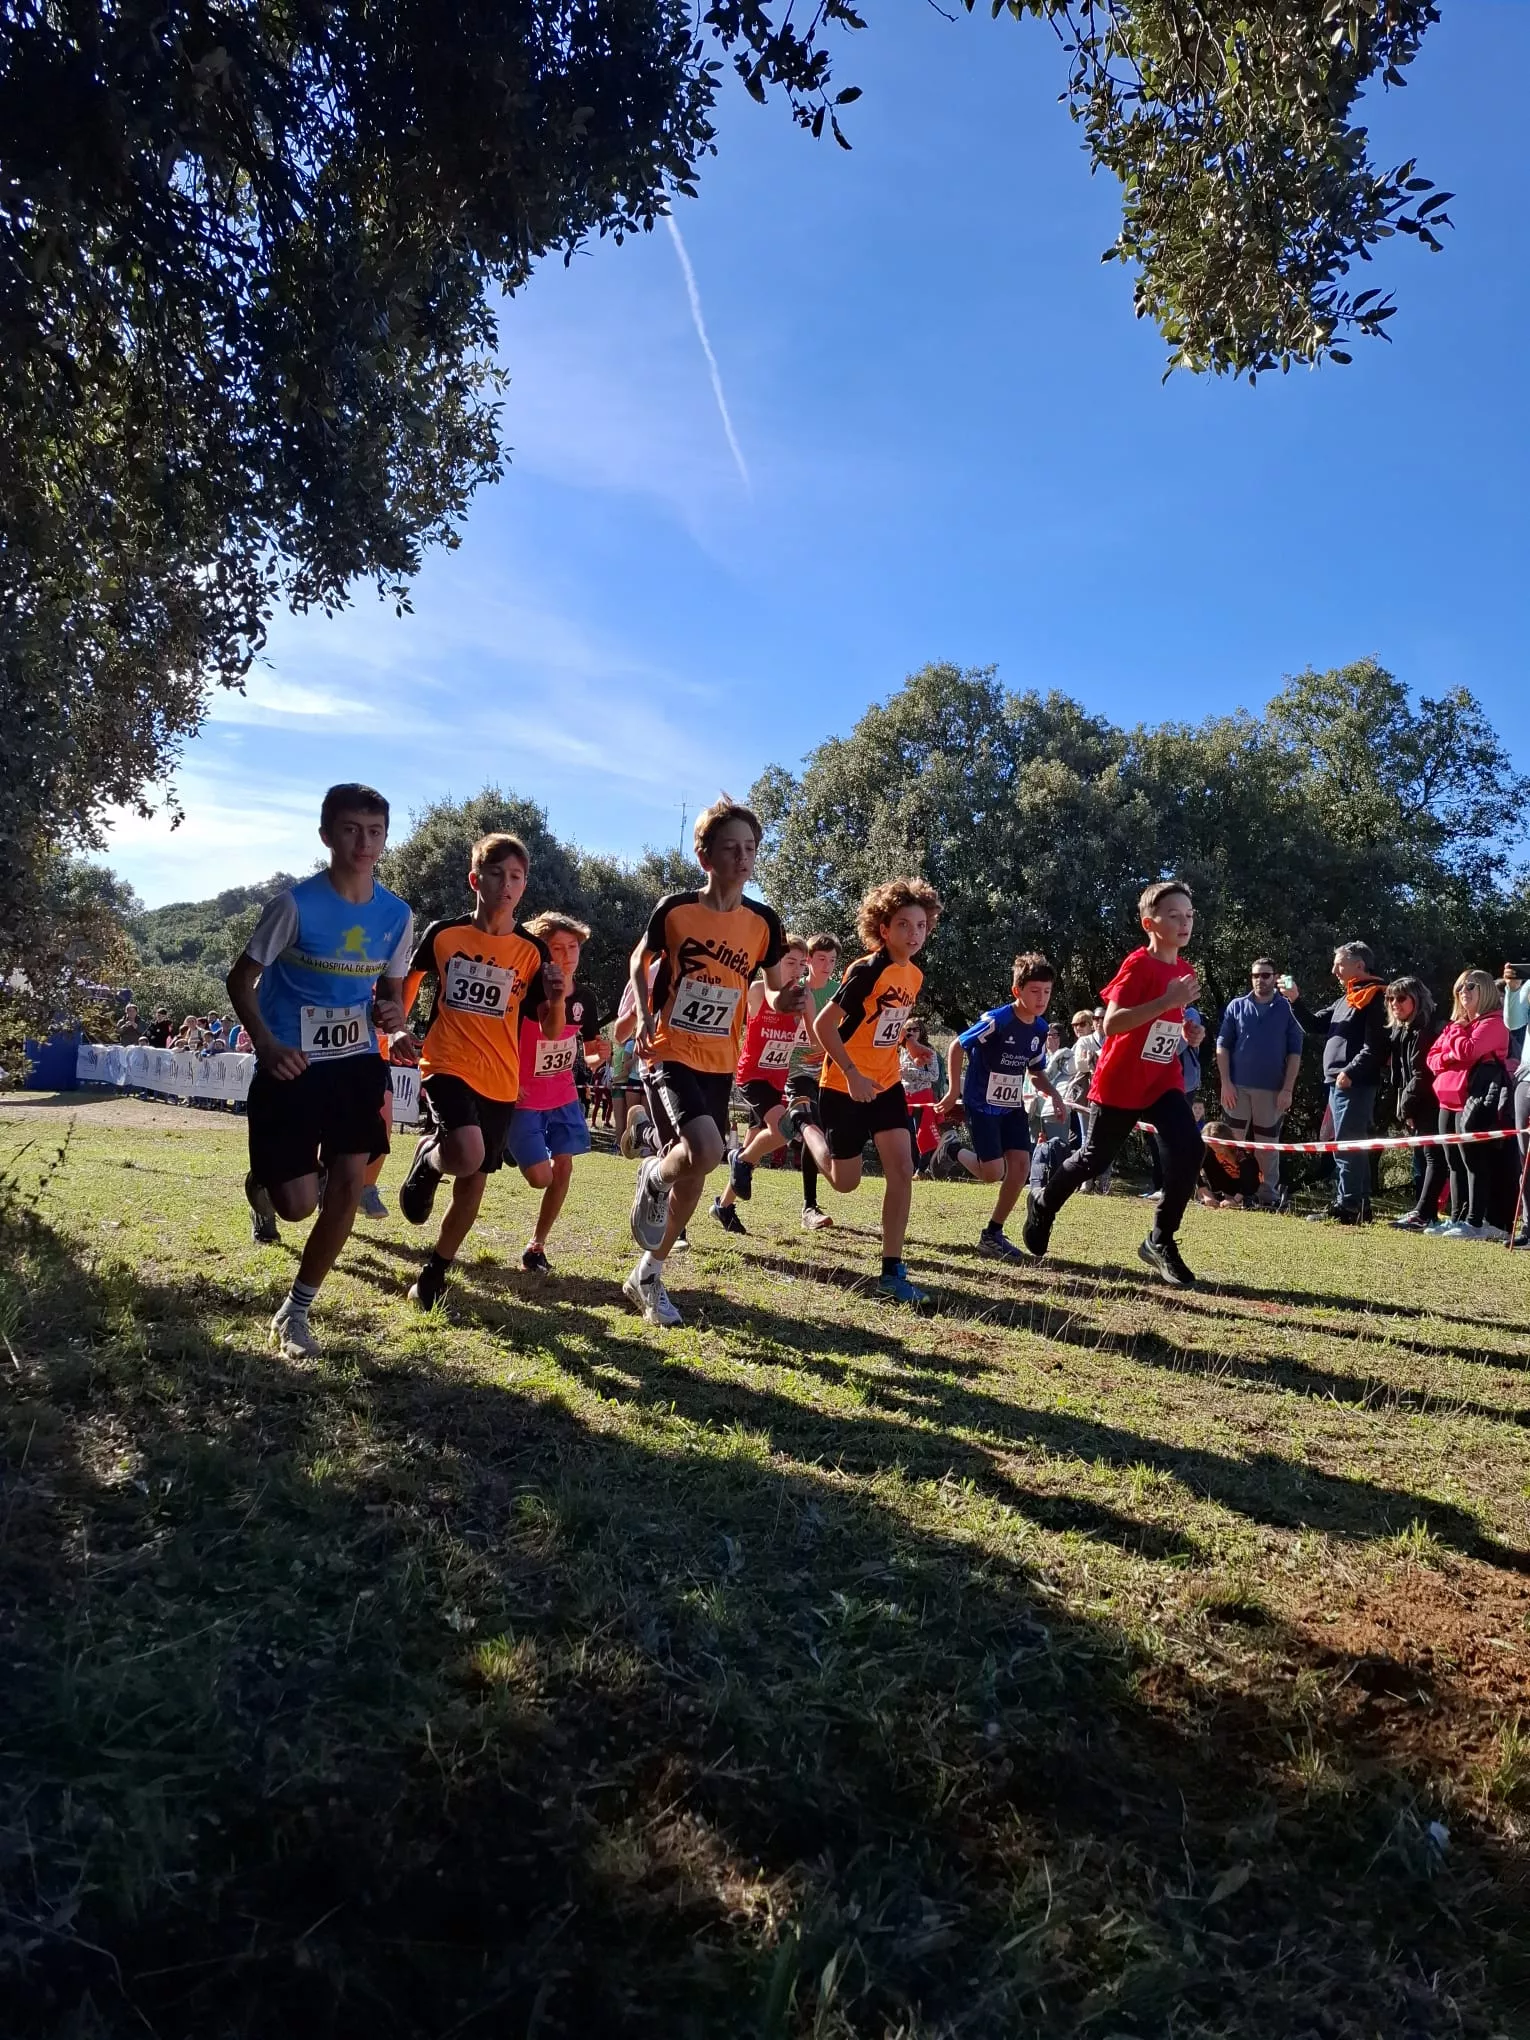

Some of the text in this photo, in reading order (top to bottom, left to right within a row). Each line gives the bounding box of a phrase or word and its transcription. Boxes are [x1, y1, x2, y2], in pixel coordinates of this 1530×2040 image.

[314, 959, 353, 972] HOSPITAL
[695, 974, 721, 985] club
[452, 978, 501, 1007] 399
[682, 1000, 729, 1026] 427
[312, 1021, 359, 1048] 400
[542, 1051, 572, 1070] 338
[765, 1050, 789, 1064] 444
[993, 1086, 1019, 1101] 404
